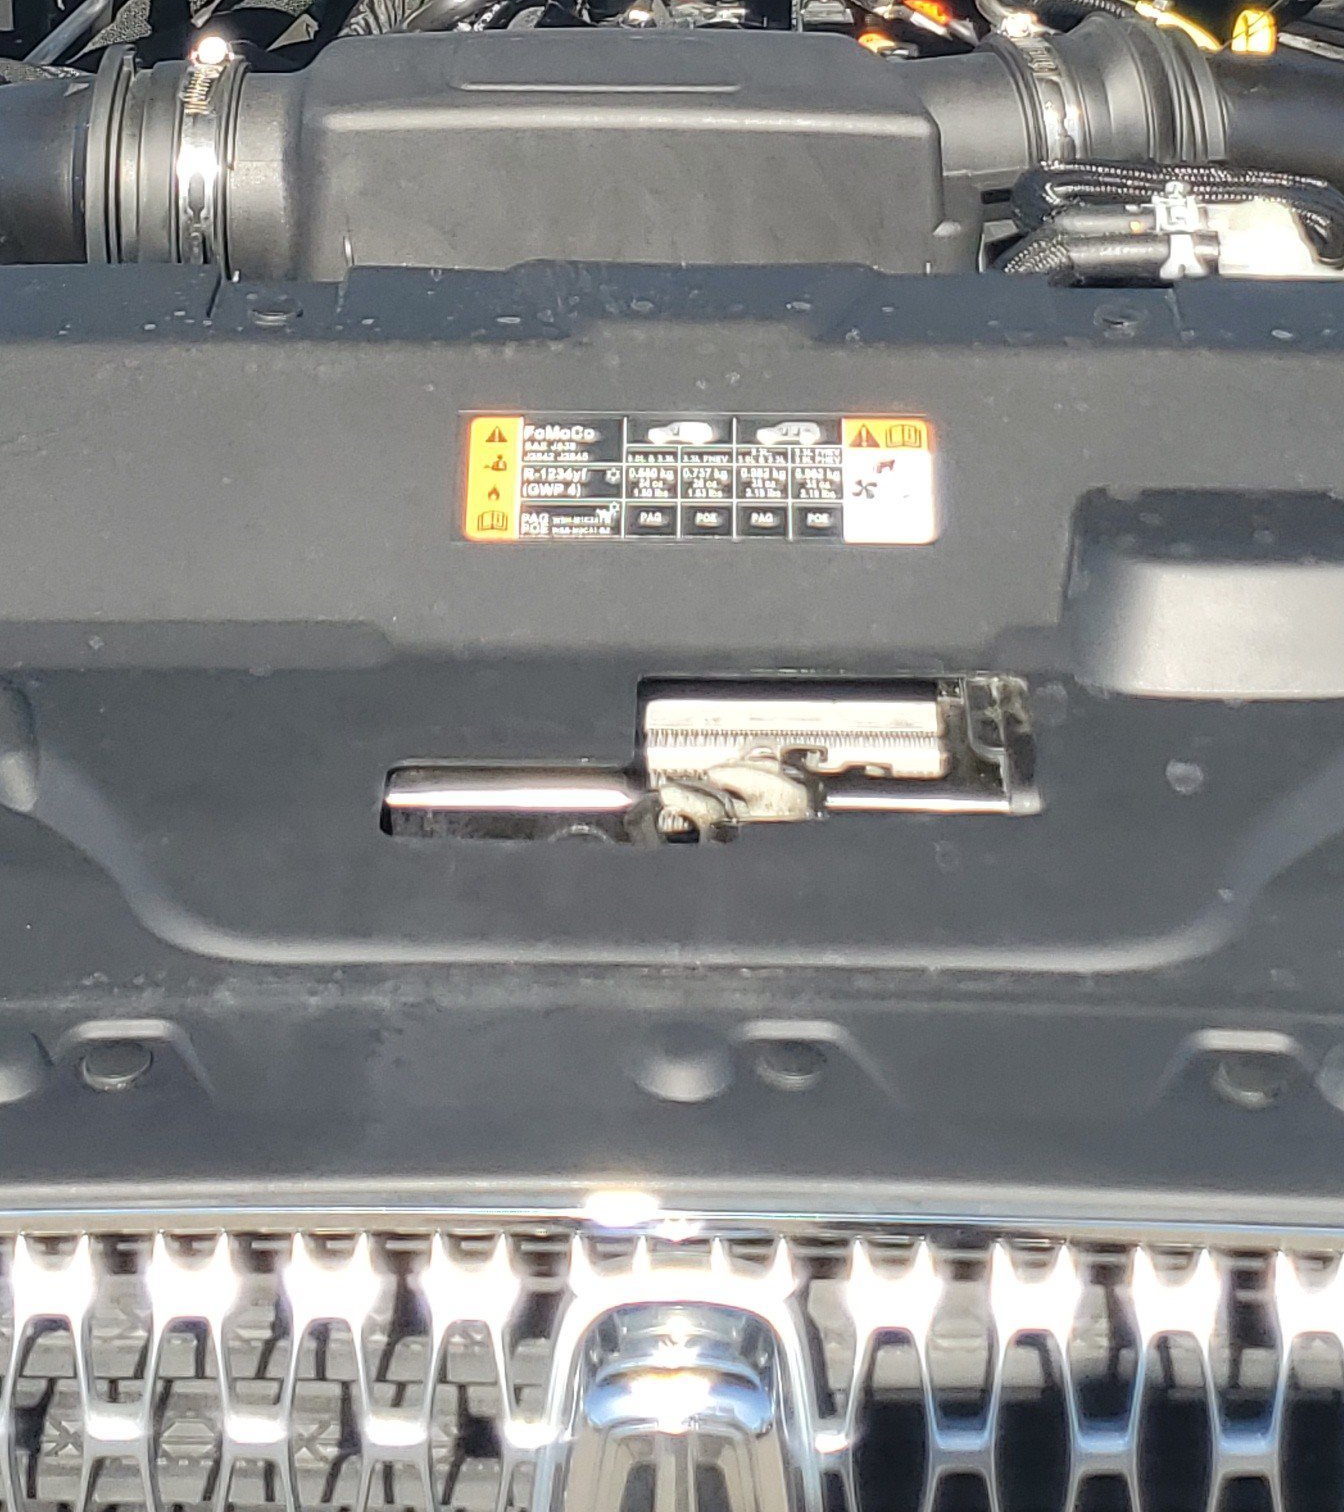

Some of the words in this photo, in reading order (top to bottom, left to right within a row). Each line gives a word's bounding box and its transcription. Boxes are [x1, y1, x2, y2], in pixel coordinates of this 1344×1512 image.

[523, 424, 597, 441] FoMoCo
[523, 468, 588, 483] R-1234yf
[714, 468, 729, 480] kg
[523, 483, 564, 497] (GWP
[567, 483, 581, 498] 4)
[522, 512, 549, 524] PAG
[640, 512, 662, 524] PAG
[751, 512, 774, 524] PAG
